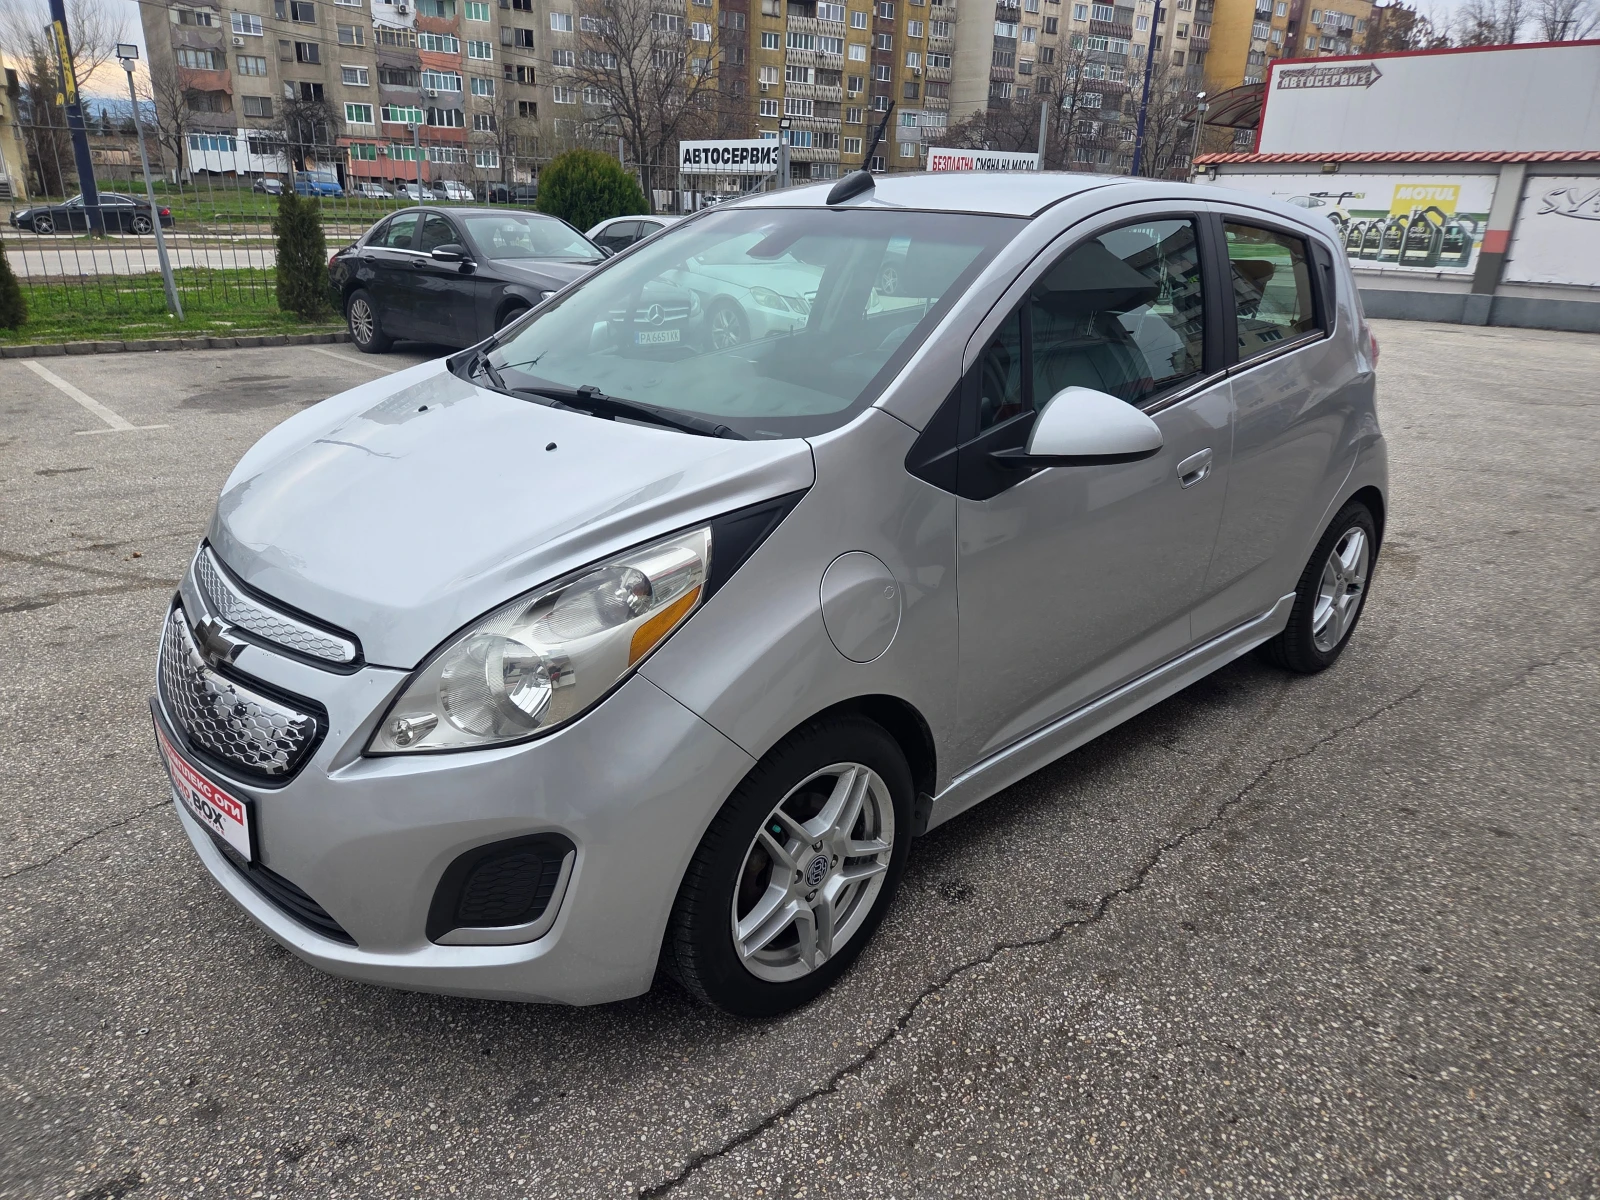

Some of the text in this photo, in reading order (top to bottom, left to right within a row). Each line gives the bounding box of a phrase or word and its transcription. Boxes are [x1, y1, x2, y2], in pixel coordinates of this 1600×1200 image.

[1281, 74, 1367, 88] АВТОСЕРВИЗ
[683, 147, 779, 164] АВТОСЕРВИЗ
[932, 156, 974, 170] БЕЗПЛАТНА
[1396, 187, 1455, 201] MOTUL
[191, 790, 224, 830] BOX
[214, 793, 241, 820] ОГИ
